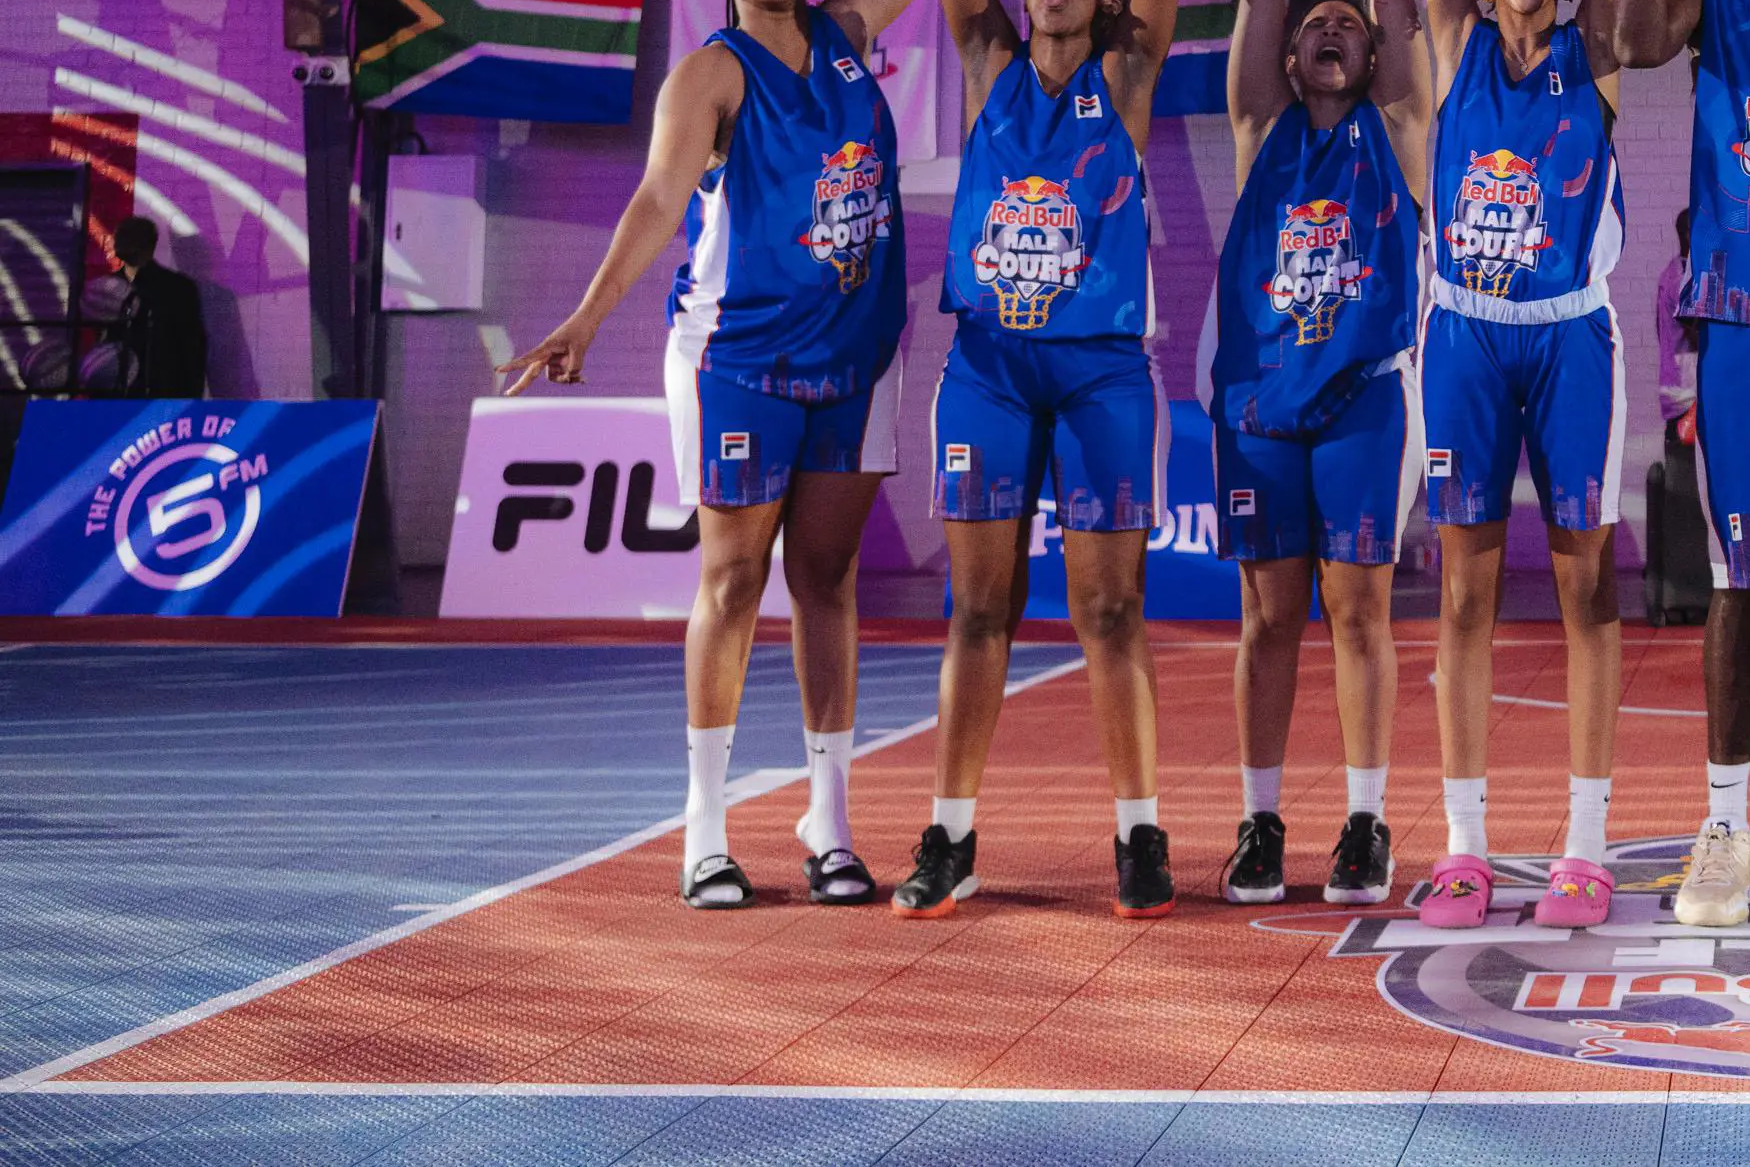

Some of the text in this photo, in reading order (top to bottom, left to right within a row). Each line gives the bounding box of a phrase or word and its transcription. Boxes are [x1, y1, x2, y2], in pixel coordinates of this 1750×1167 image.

[817, 164, 882, 201] Red Bull
[1463, 177, 1496, 203] Red
[991, 202, 1076, 227] Red Bull
[1003, 233, 1058, 251] HALF
[1280, 229, 1319, 251] Red
[1451, 222, 1544, 269] COURT
[976, 244, 1082, 288] COURT
[85, 415, 236, 537] THE POWER OF
[218, 453, 269, 491] FM
[146, 472, 227, 559] 5
[493, 460, 700, 554] FIL
